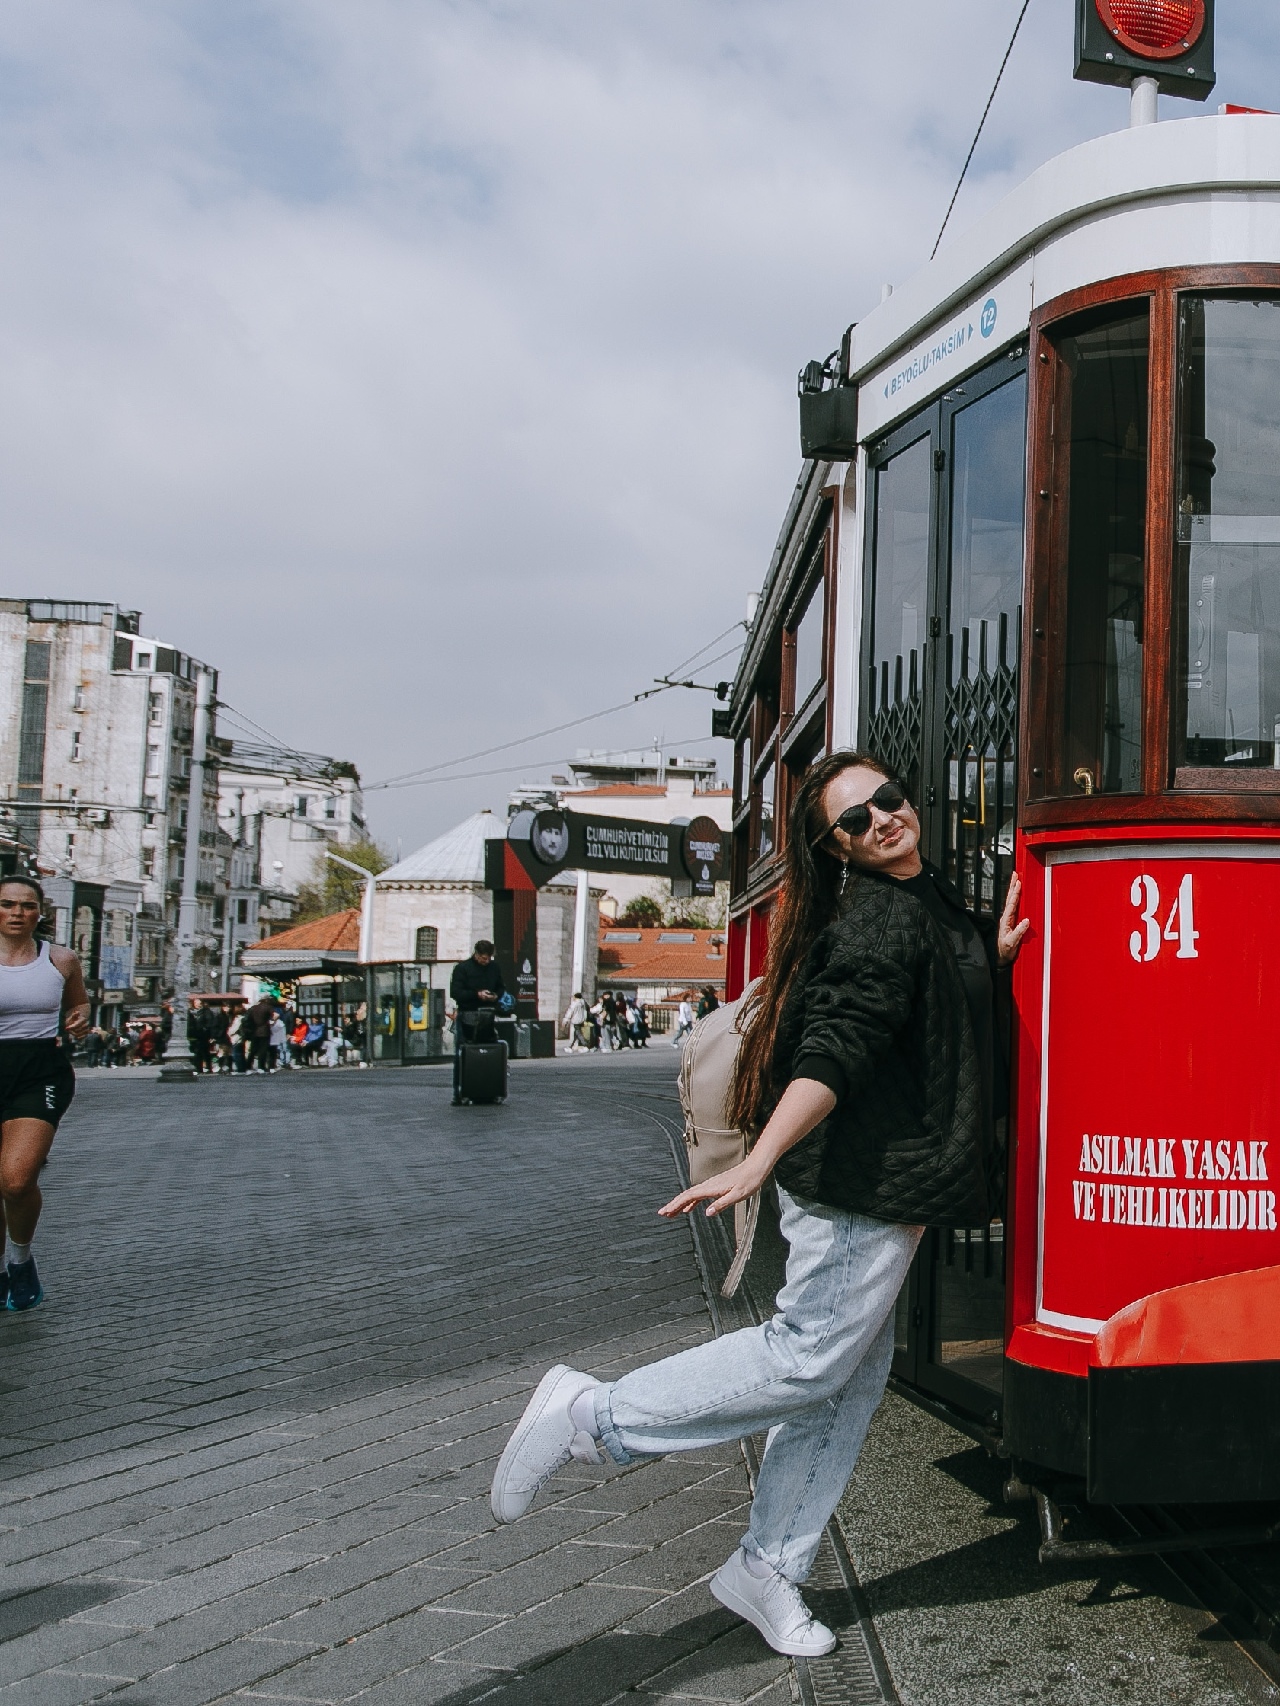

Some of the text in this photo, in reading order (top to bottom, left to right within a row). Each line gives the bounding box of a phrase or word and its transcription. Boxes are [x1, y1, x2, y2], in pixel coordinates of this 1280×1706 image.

[1129, 873, 1199, 963] 34
[1078, 1133, 1269, 1181] ASILMAK YASAK
[1072, 1180, 1278, 1231] VE TEHLIKELIDIR
